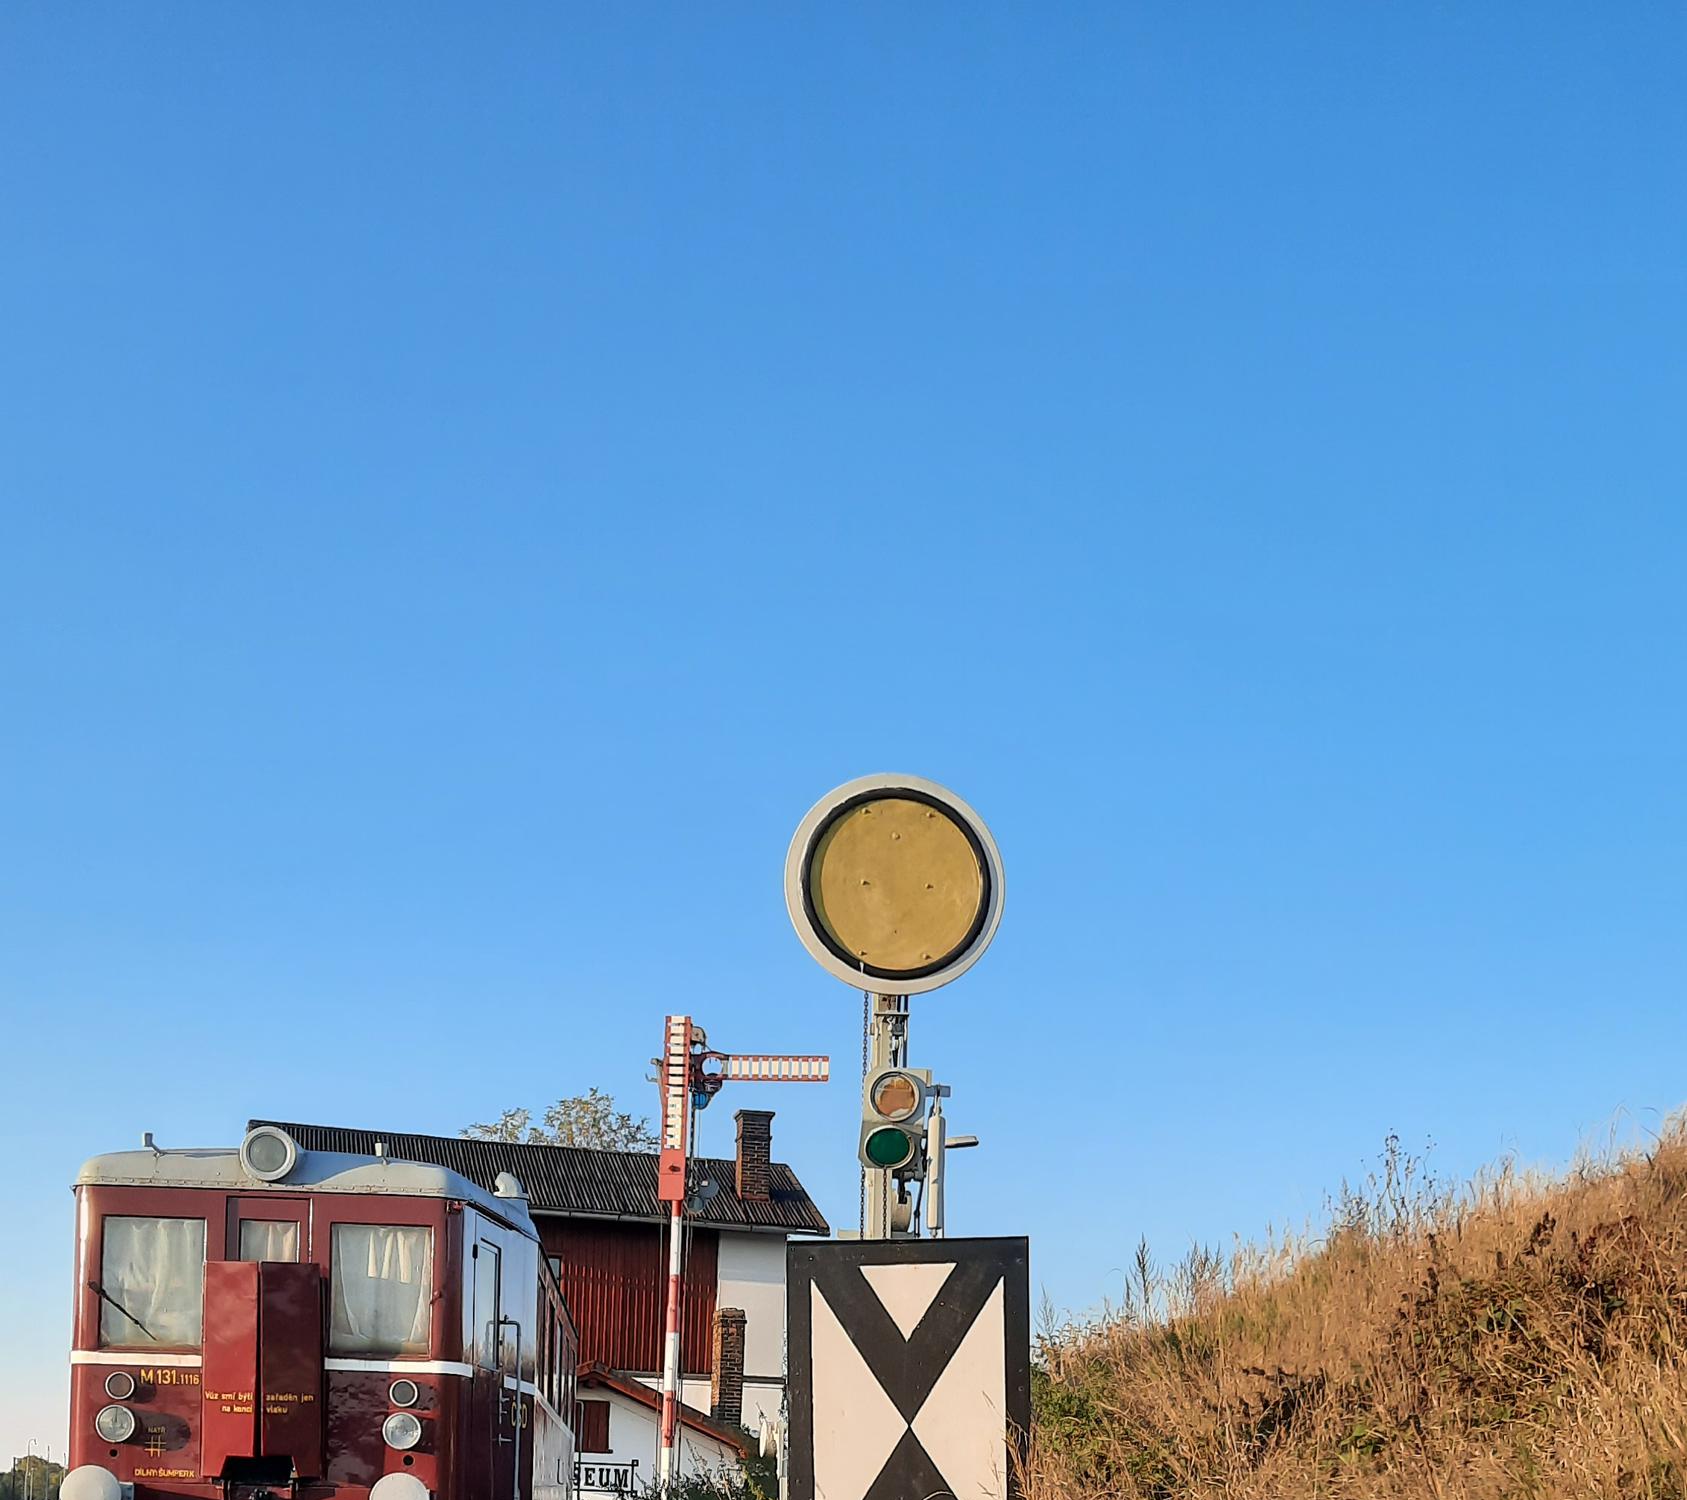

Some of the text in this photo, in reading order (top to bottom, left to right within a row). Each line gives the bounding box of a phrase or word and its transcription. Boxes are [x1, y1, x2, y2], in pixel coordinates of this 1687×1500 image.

[140, 1368, 154, 1385] M
[205, 1390, 219, 1400] Vůz
[221, 1391, 236, 1401] smí
[301, 1392, 314, 1403] jen
[233, 1404, 253, 1413] konci
[266, 1404, 288, 1414] vlaku
[511, 1396, 528, 1429] ČD
[158, 1467, 195, 1478] ŠUMPERK
